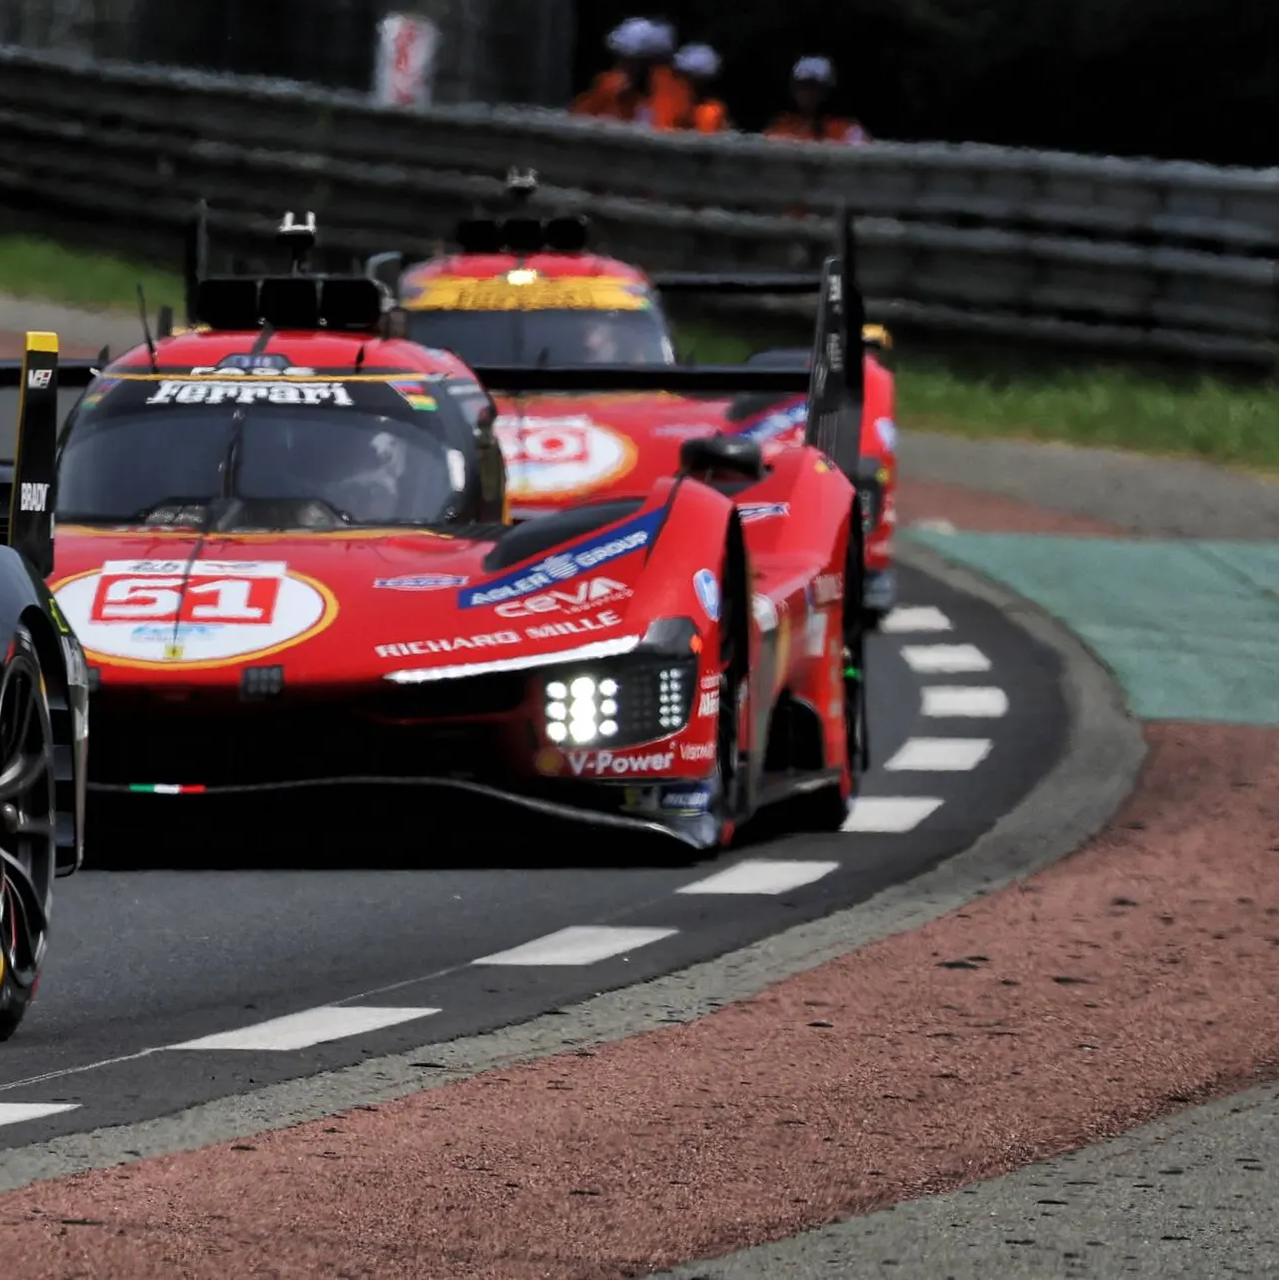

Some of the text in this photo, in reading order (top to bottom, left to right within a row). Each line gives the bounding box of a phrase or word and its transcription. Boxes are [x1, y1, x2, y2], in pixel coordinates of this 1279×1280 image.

[145, 379, 355, 407] Ferrari
[575, 530, 649, 567] GROUP
[101, 578, 265, 619] 51
[375, 610, 622, 658] RICHARD MILLE
[568, 751, 675, 775] V-Power
